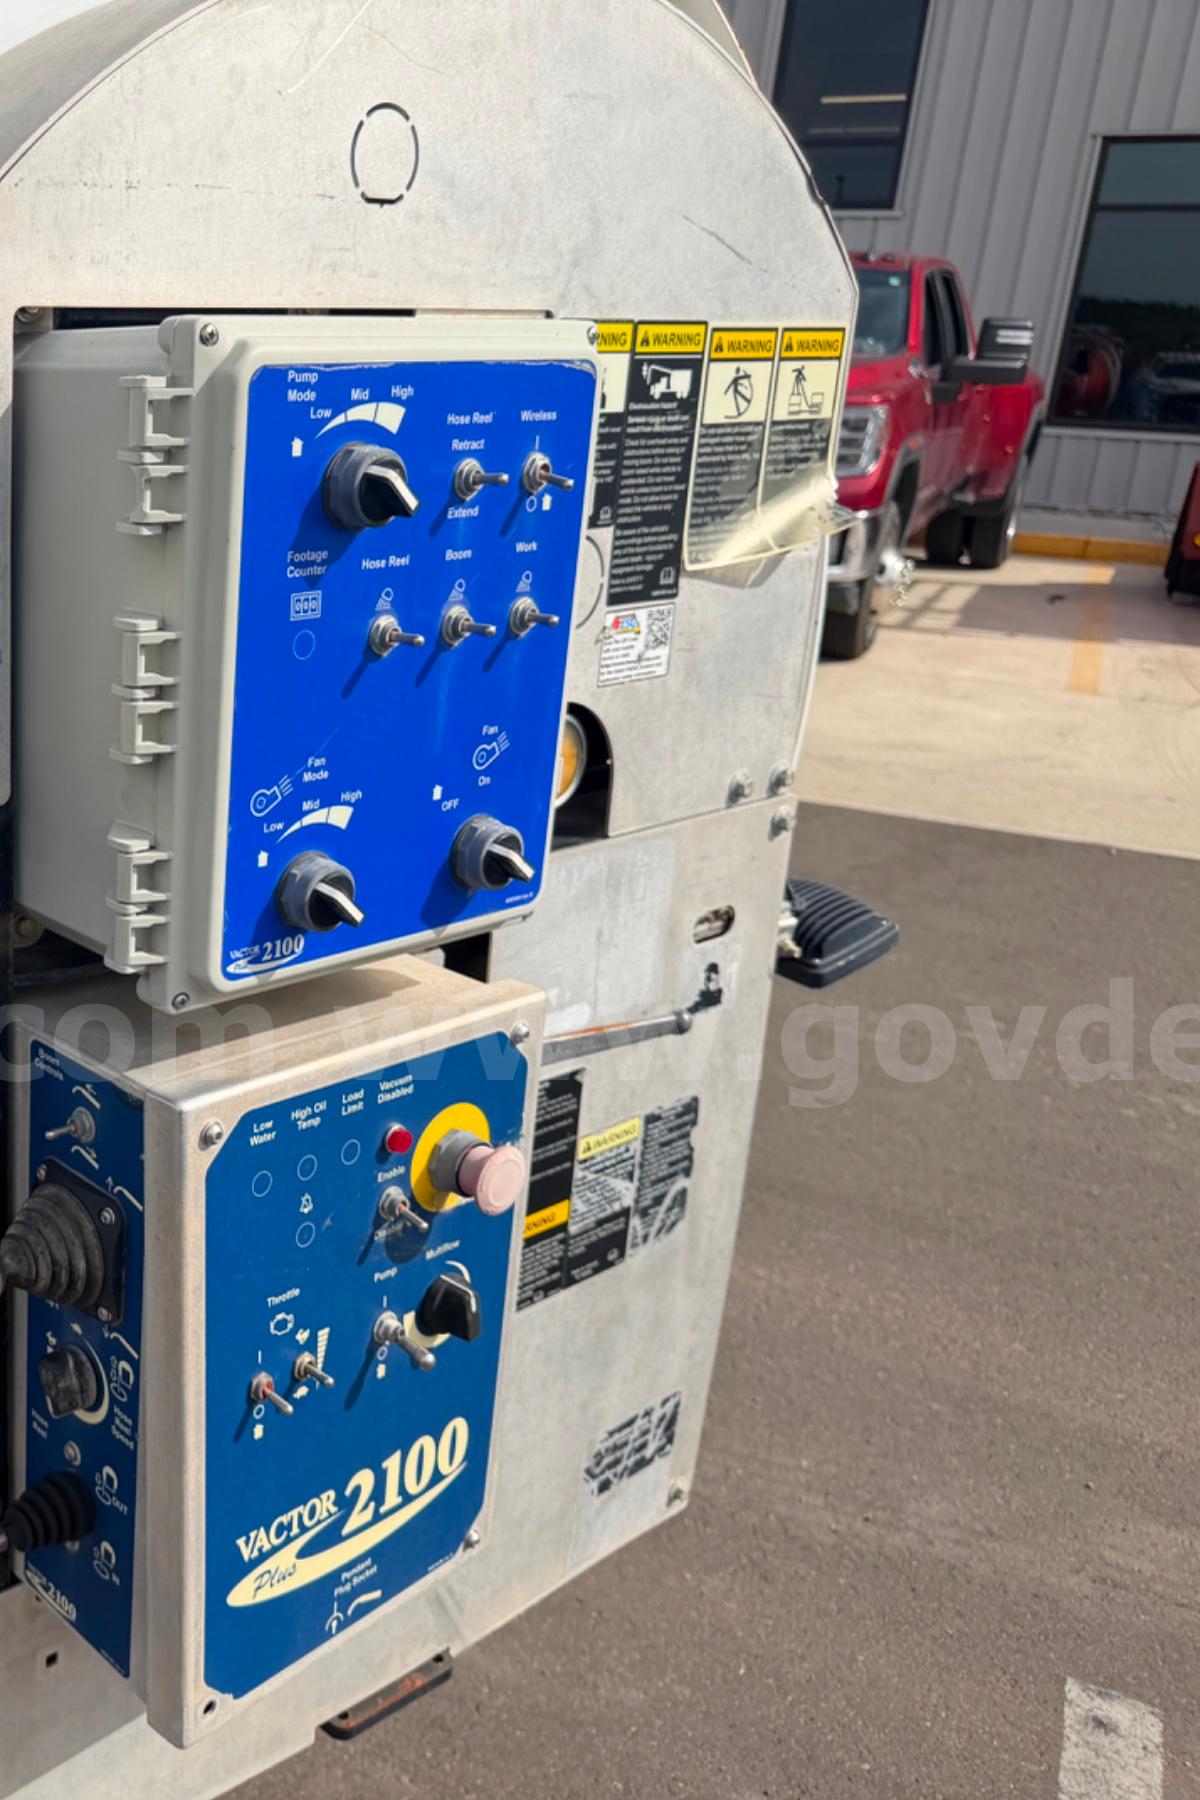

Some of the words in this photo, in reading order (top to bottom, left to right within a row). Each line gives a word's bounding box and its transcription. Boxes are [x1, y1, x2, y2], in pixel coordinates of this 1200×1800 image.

[652, 332, 701, 347] WARNING
[727, 339, 772, 353] WARNING
[796, 338, 839, 352] WARNING
[288, 370, 318, 384] Pump
[288, 389, 316, 402] Mode
[351, 388, 369, 400] Mid
[391, 385, 414, 399] High
[310, 407, 331, 419] Low
[447, 413, 469, 425] Hose
[472, 412, 493, 424] Reel
[521, 410, 557, 422] Wireless
[452, 438, 485, 450] Retract
[448, 506, 479, 519] Extend
[516, 541, 537, 553] Work
[287, 550, 328, 563] Footage
[445, 549, 472, 561] Boom
[362, 557, 385, 570] Hose
[389, 555, 410, 568] Reel
[287, 565, 327, 578] Counter
[483, 725, 498, 735] Fan
[308, 757, 326, 768] Fan
[303, 769, 329, 782] Mode
[479, 776, 491, 786] On
[341, 789, 363, 802] High
[302, 799, 320, 811] Mid
[442, 799, 459, 811] OFF
[264, 822, 284, 833] Low
[262, 934, 305, 961] 2100
[35, 1058, 64, 1081] Controls
[379, 1074, 412, 1091] Vacuum
[343, 1088, 364, 1104] Load
[377, 1084, 414, 1104] Disabled
[291, 1107, 312, 1121] High
[314, 1100, 326, 1113] Oil
[341, 1101, 364, 1116] Limit
[253, 1120, 273, 1133] Low
[297, 1116, 321, 1131] Temp
[250, 1130, 276, 1146] Water
[378, 1166, 405, 1182] Enable
[374, 1266, 397, 1283] Pump
[267, 1287, 300, 1307] Throttle
[236, 1489, 338, 1562] VACTOR
[341, 1416, 469, 1536] 2100
[112, 1499, 129, 1516] OUT
[341, 1557, 372, 1582] Pendant
[252, 1564, 297, 1598] Plus
[334, 1582, 351, 1597] Plug
[352, 1564, 377, 1586] Socket
[47, 1581, 77, 1619] 2100
